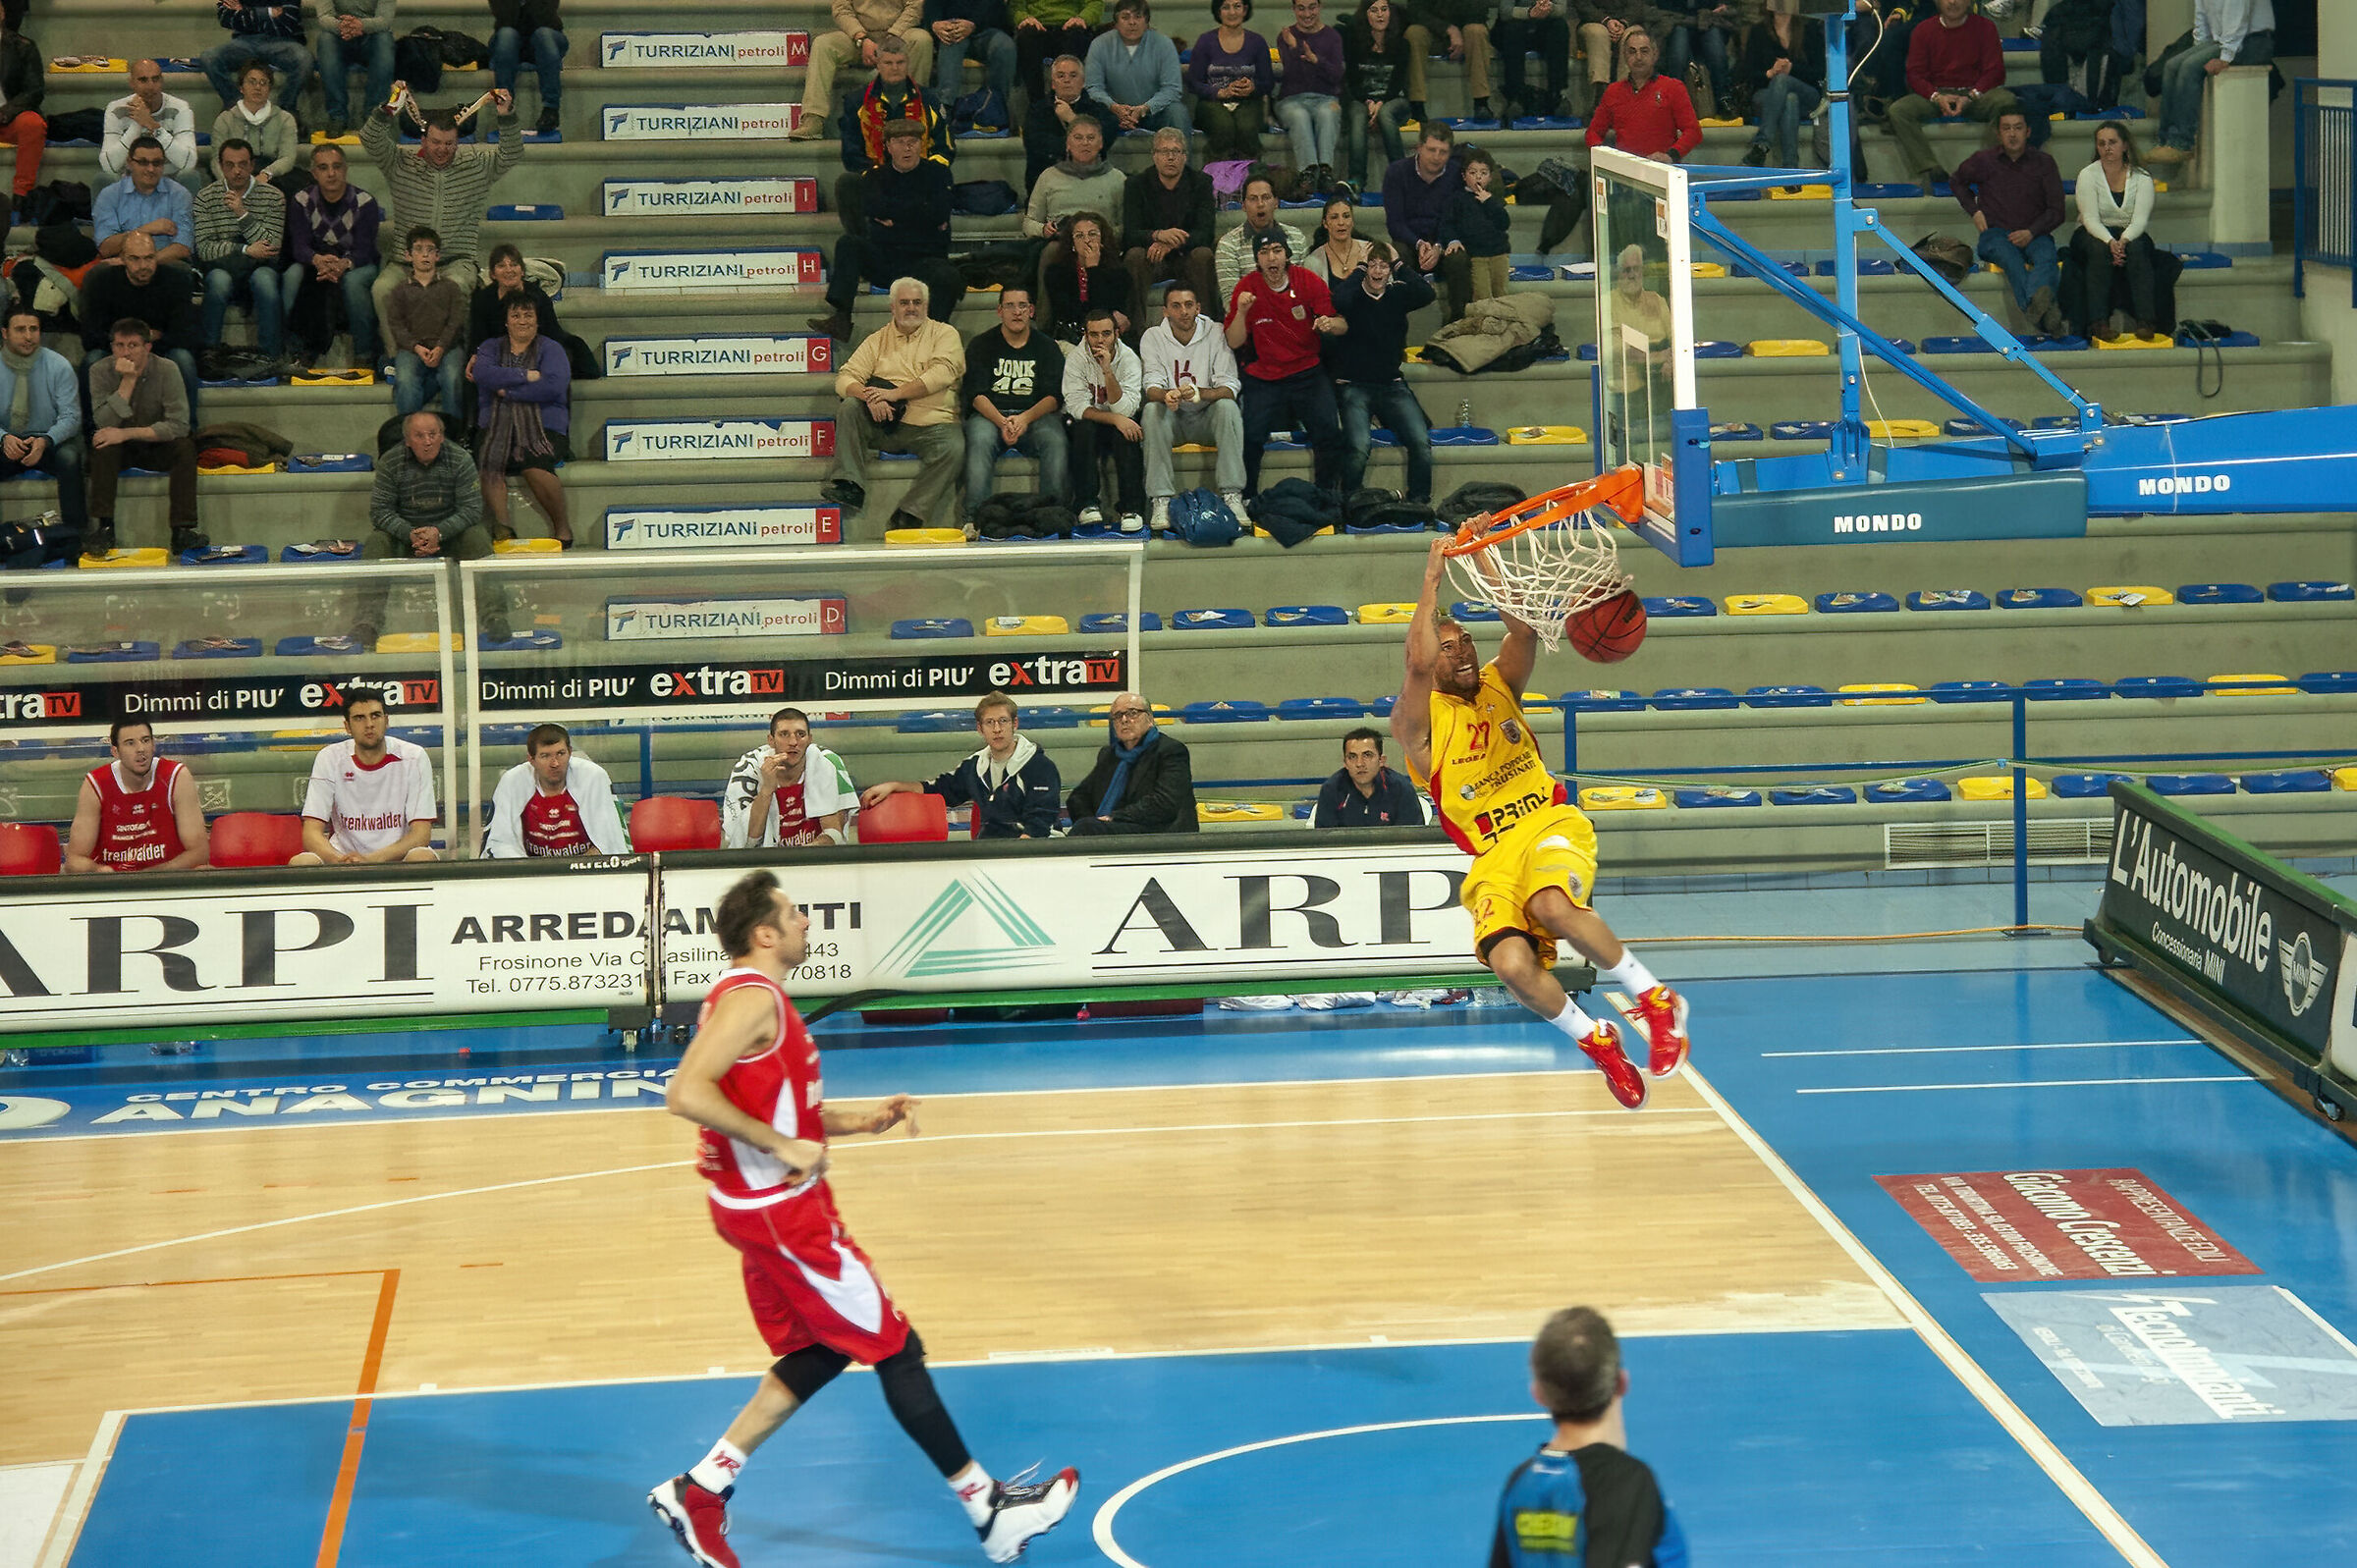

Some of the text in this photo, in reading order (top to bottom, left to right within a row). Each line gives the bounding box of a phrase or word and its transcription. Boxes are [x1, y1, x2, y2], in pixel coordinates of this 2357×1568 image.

[634, 42, 807, 60] TURRIZIANI petroli M
[637, 116, 790, 132] TURRIZIANI petroli
[638, 190, 741, 206] TURRIZIANI
[744, 192, 793, 206] petroli
[638, 259, 815, 279] TURRIZIANI petroli H
[640, 346, 828, 365] TURRIZIANI petroli G
[993, 357, 1036, 379] JONK
[642, 429, 826, 450] TURRIZIANI petroli F
[2138, 474, 2230, 496] MONDO
[643, 516, 832, 538] TURRIZIANI petroli E
[1834, 513, 1922, 533] MONDO
[645, 607, 839, 629] TURRIZIANI petroli D
[482, 679, 556, 700] Dimmi
[562, 678, 582, 698] di
[825, 669, 897, 690] Dimmi
[903, 668, 922, 687] di
[125, 692, 201, 713] Dimmi
[208, 690, 231, 710] di
[2111, 808, 2273, 973] L'Automobile
[479, 953, 583, 972] Frosinone
[589, 950, 626, 968] Via
[2152, 921, 2226, 986] Concessionaria MINI
[466, 976, 500, 995] Tel.
[509, 971, 645, 994] 0775.873231
[674, 969, 710, 987] Fax
[126, 1084, 348, 1104] CENTRO
[1998, 1171, 2179, 1275] Giacomo Crescenzi
